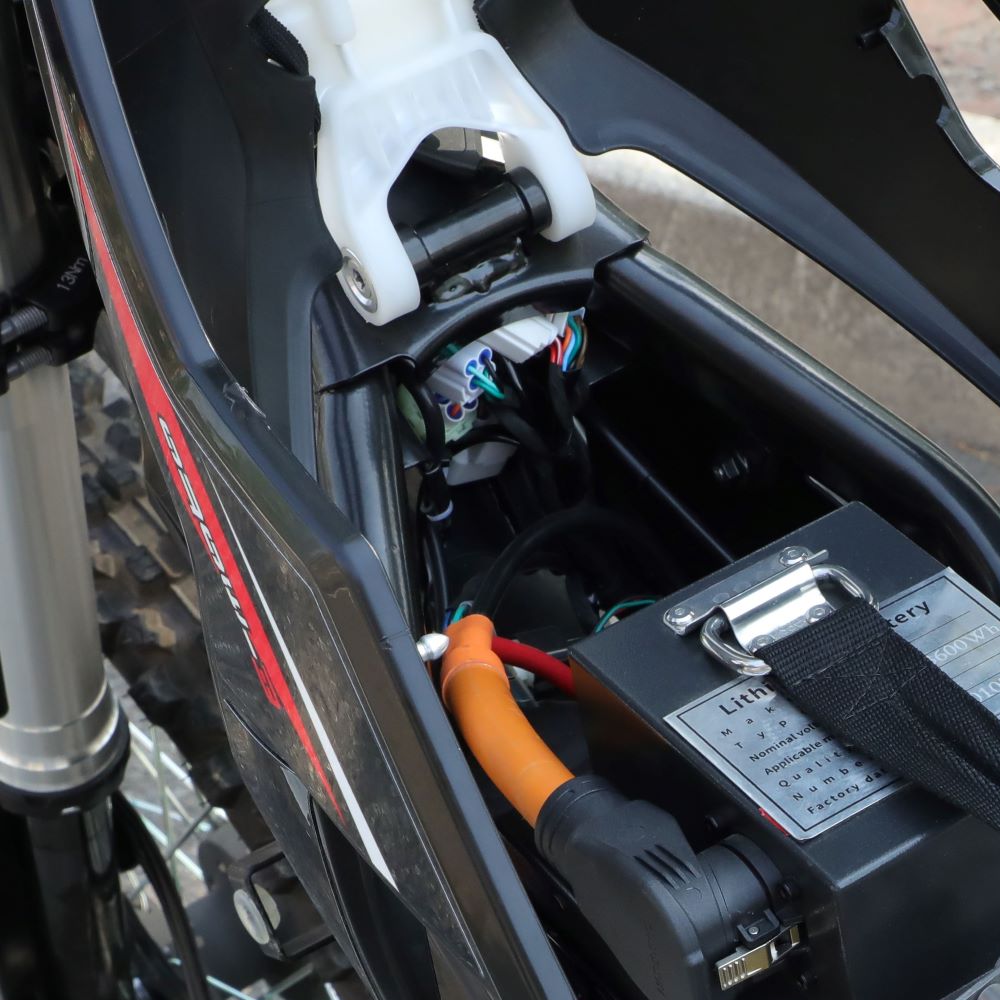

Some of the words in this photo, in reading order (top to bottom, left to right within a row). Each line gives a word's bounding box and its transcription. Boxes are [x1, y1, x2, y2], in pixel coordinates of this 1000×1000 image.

[749, 732, 797, 762] Nominal
[764, 740, 822, 775] Applicable
[807, 784, 860, 815] Factory
